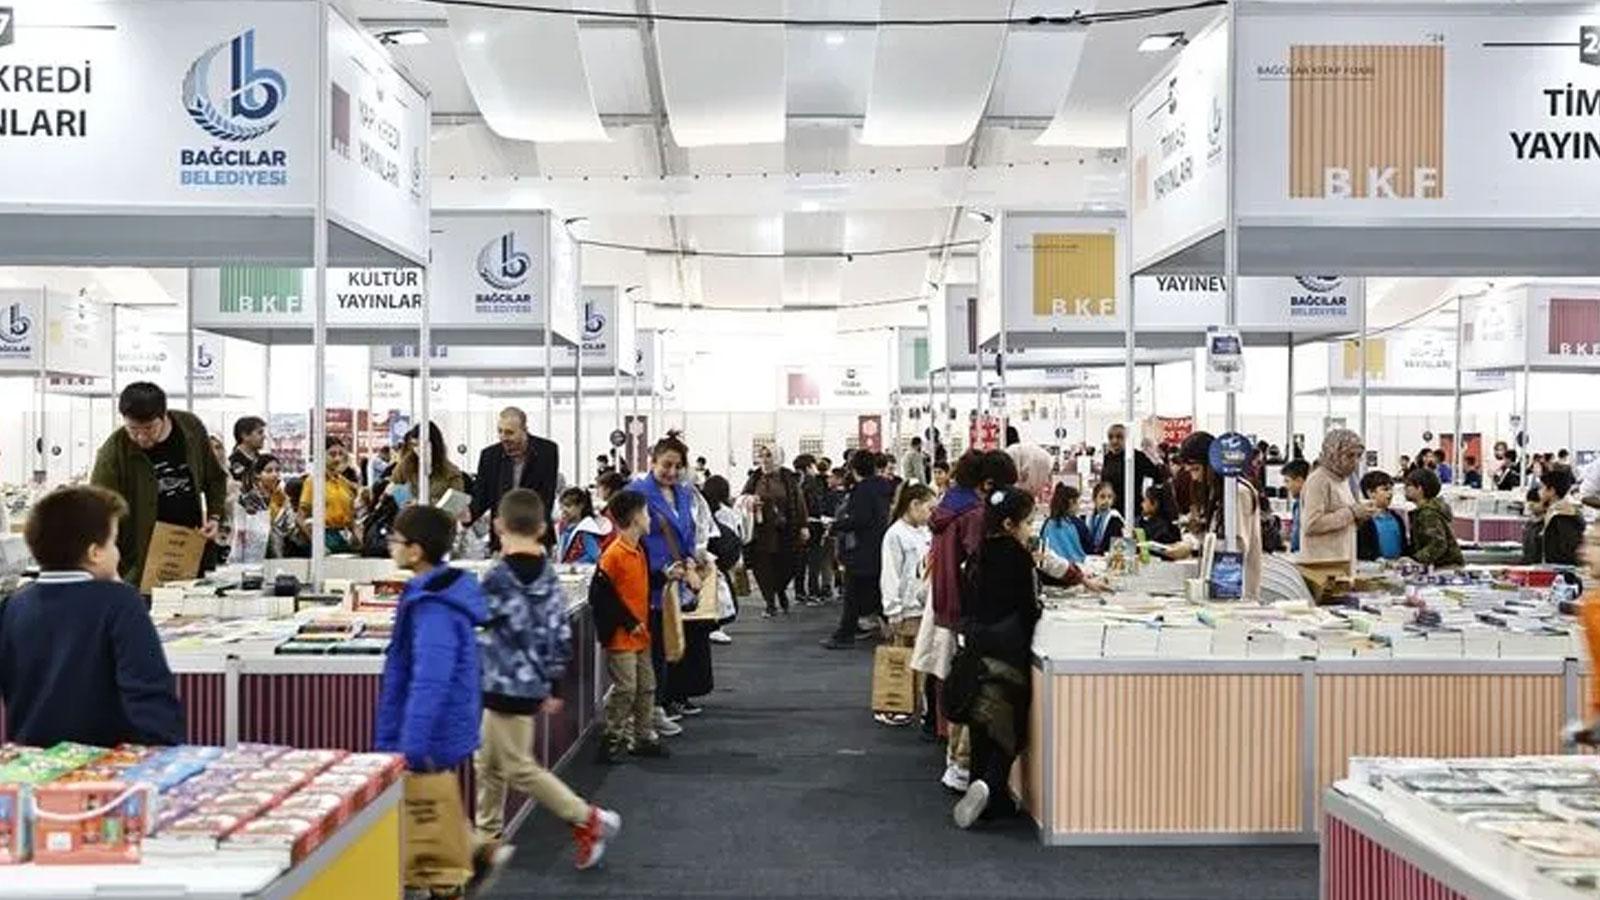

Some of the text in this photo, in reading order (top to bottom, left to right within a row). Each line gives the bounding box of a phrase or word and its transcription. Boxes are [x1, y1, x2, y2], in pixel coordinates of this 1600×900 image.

[0, 60, 92, 94] KREDİ
[0, 108, 87, 138] LARI
[180, 146, 287, 167] BAĞCILAR
